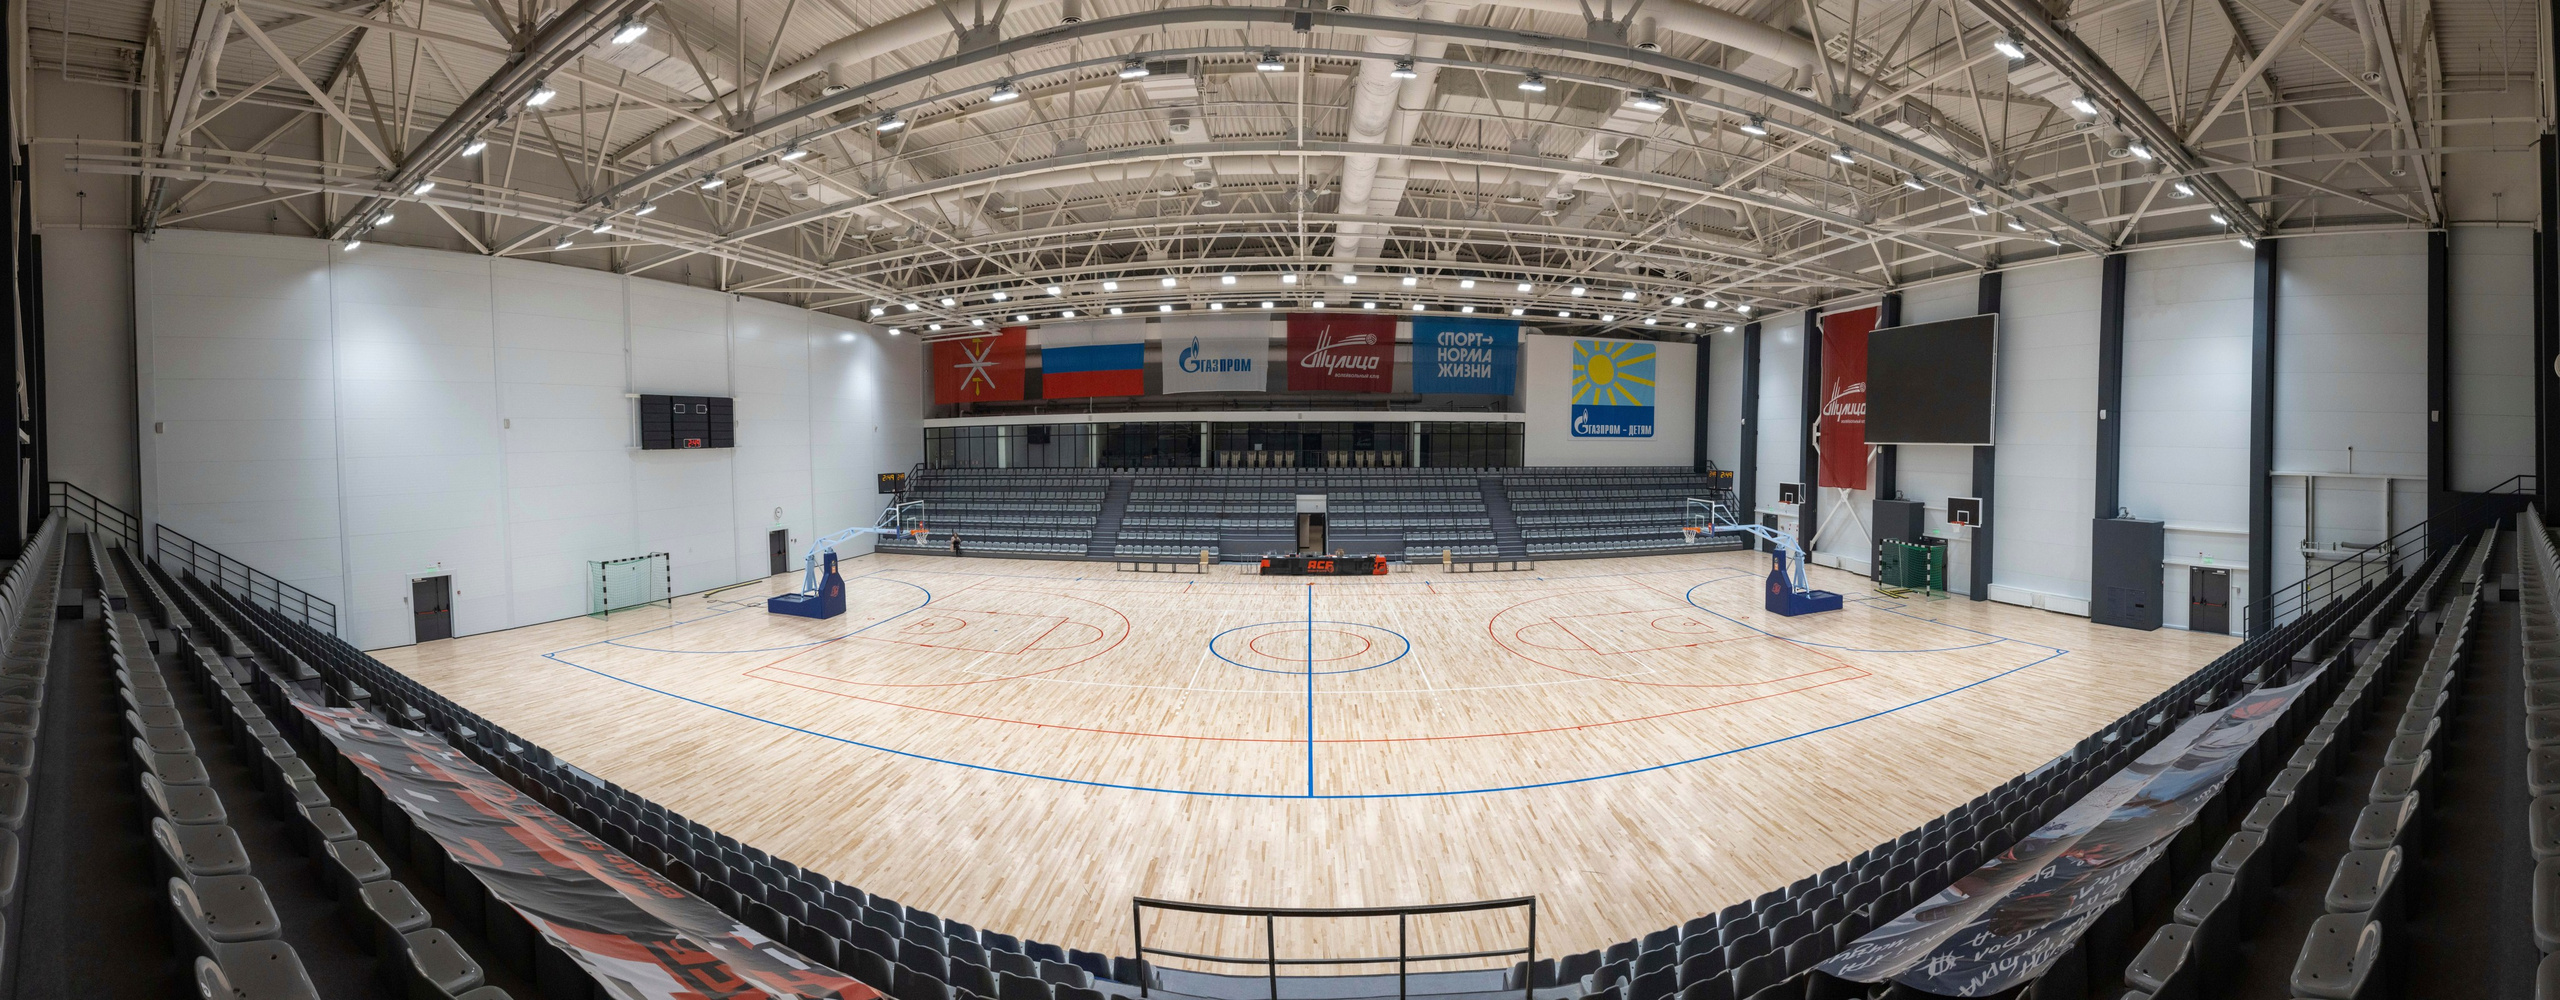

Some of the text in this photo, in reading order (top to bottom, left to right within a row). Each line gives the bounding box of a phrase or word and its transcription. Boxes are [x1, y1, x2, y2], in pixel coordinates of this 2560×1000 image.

[1437, 331, 1484, 347] СПОРТ
[1437, 347, 1492, 363] НОРМА
[1200, 358, 1252, 373] ГАЗПРОМ
[1437, 363, 1492, 379] ЖИЗНИ
[1588, 424, 1621, 435] ГАЗПРОМ
[1628, 425, 1652, 436] ДЕТЯМ
